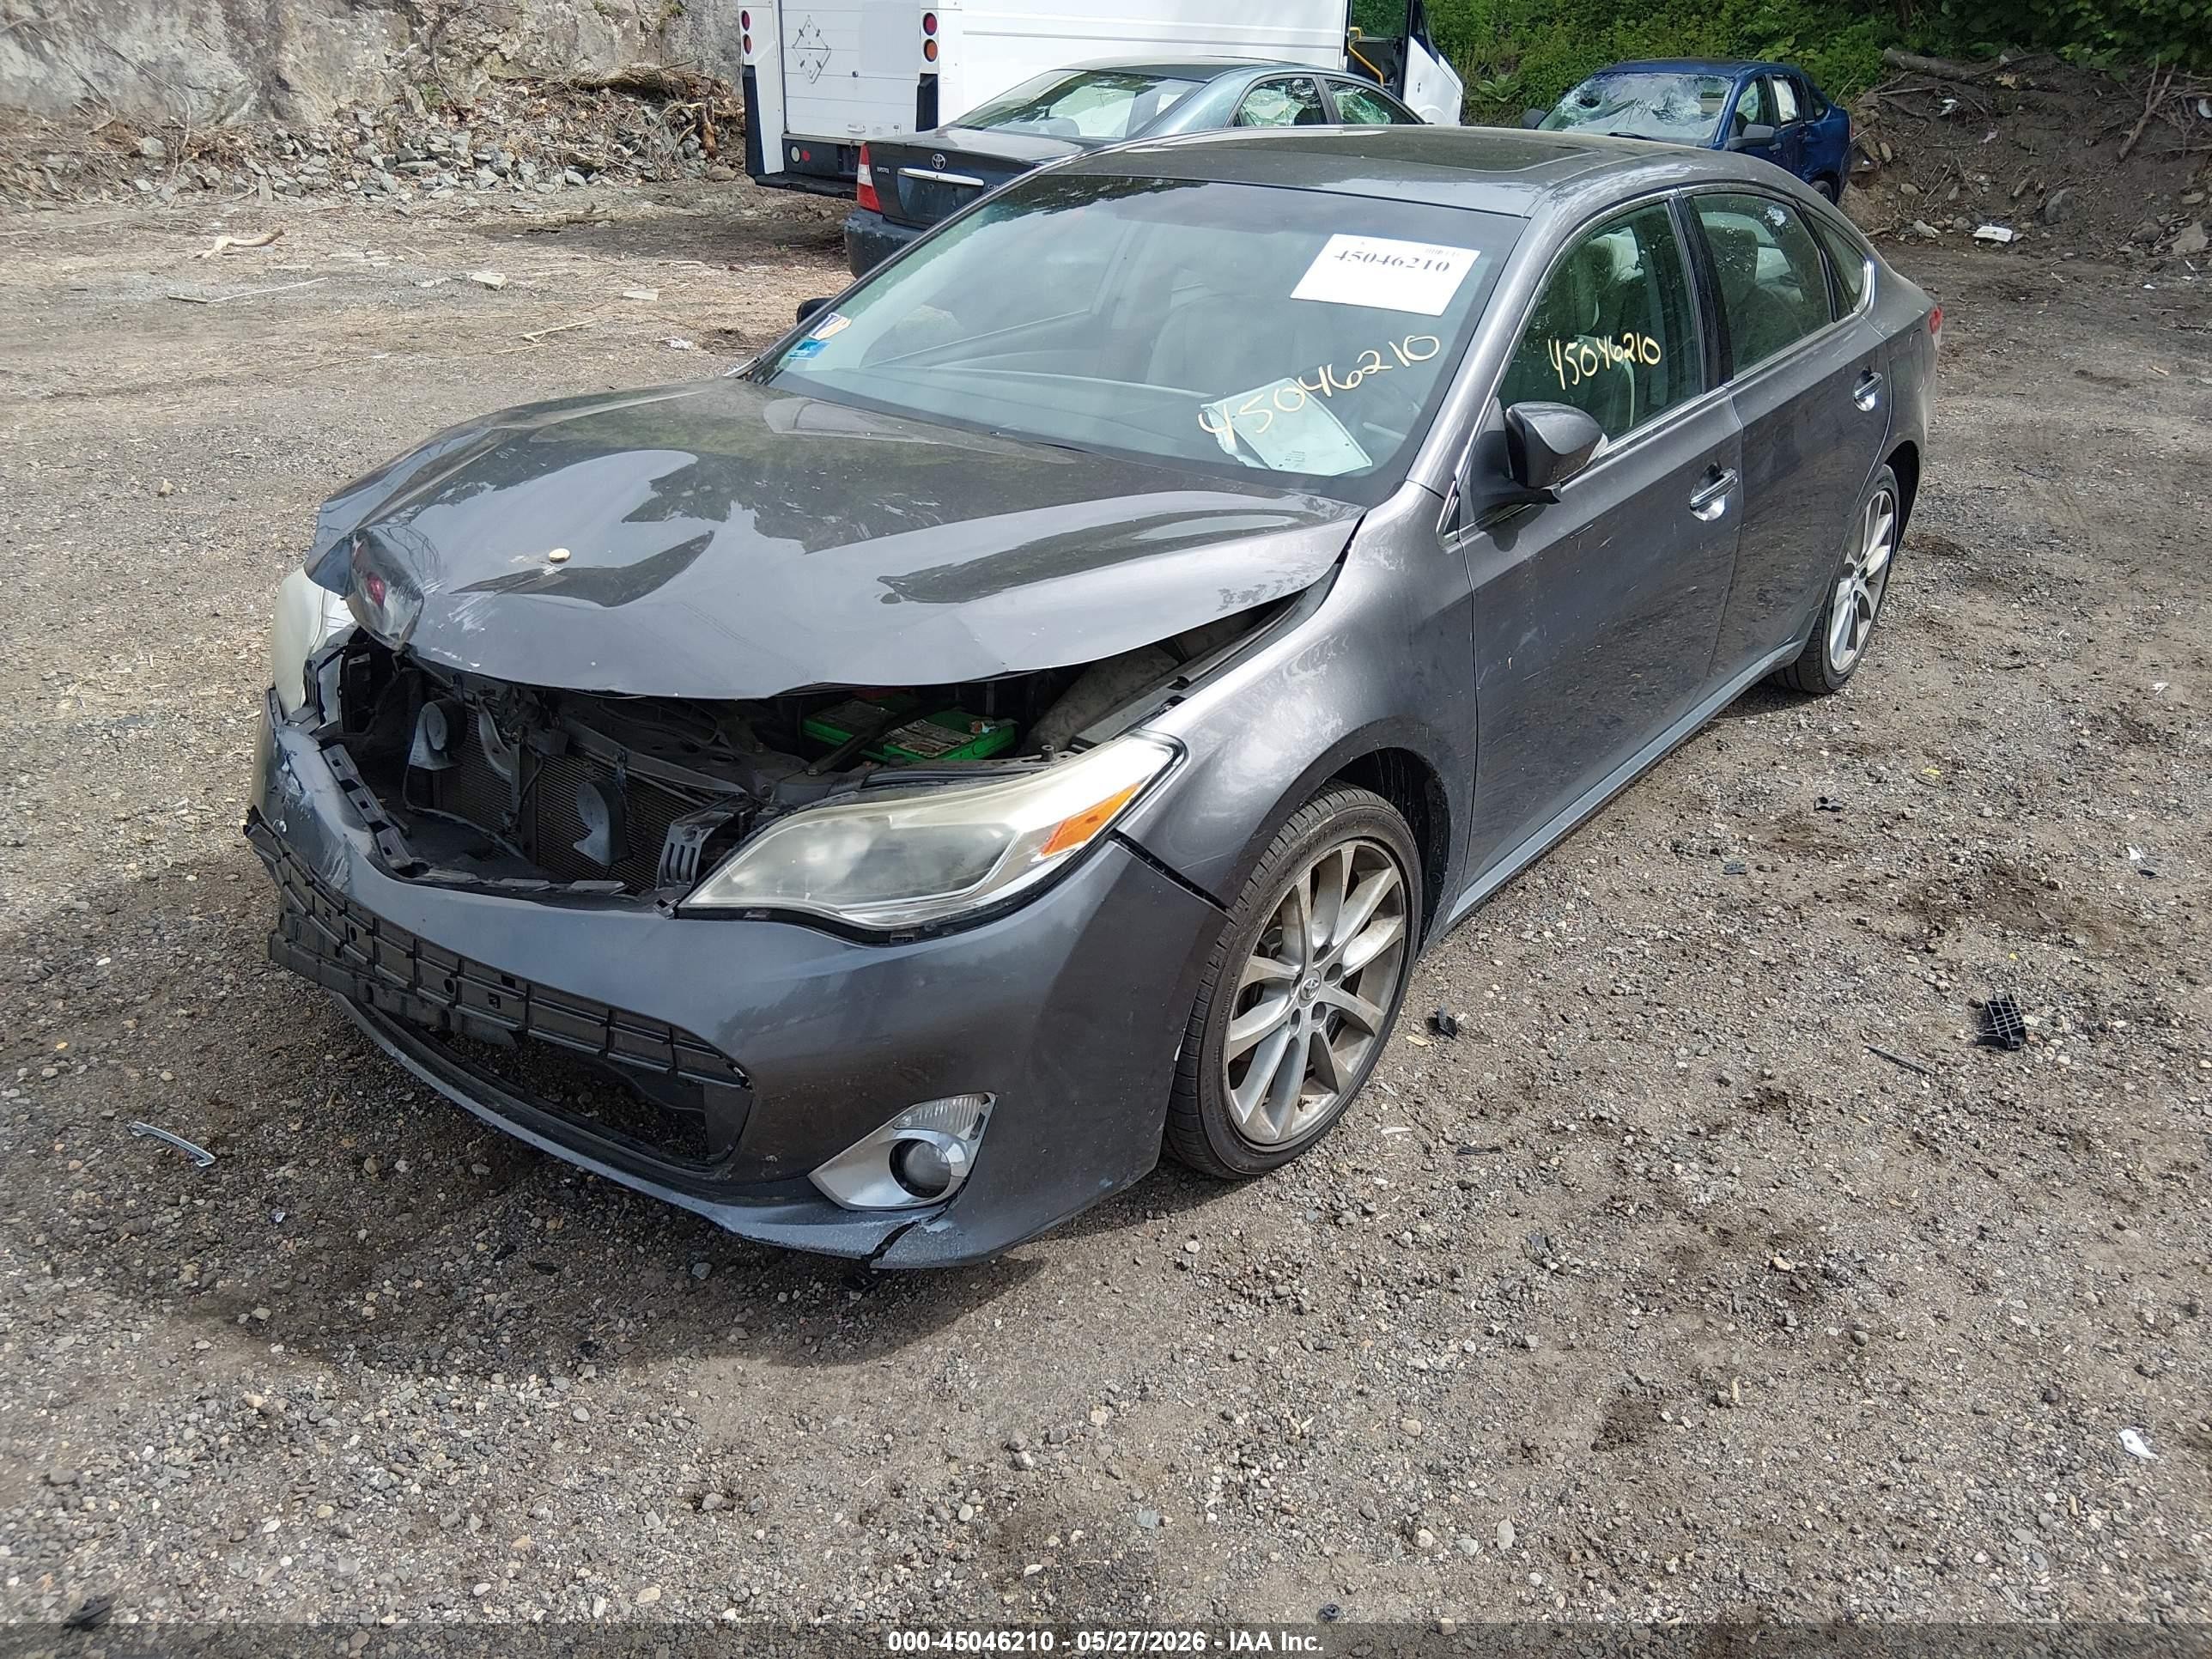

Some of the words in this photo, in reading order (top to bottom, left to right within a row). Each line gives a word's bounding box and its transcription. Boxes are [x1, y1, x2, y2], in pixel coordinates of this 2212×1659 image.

[1334, 249, 1450, 272] 45046210
[1197, 334, 1441, 447] 45046210
[1547, 331, 1662, 391] 45046210
